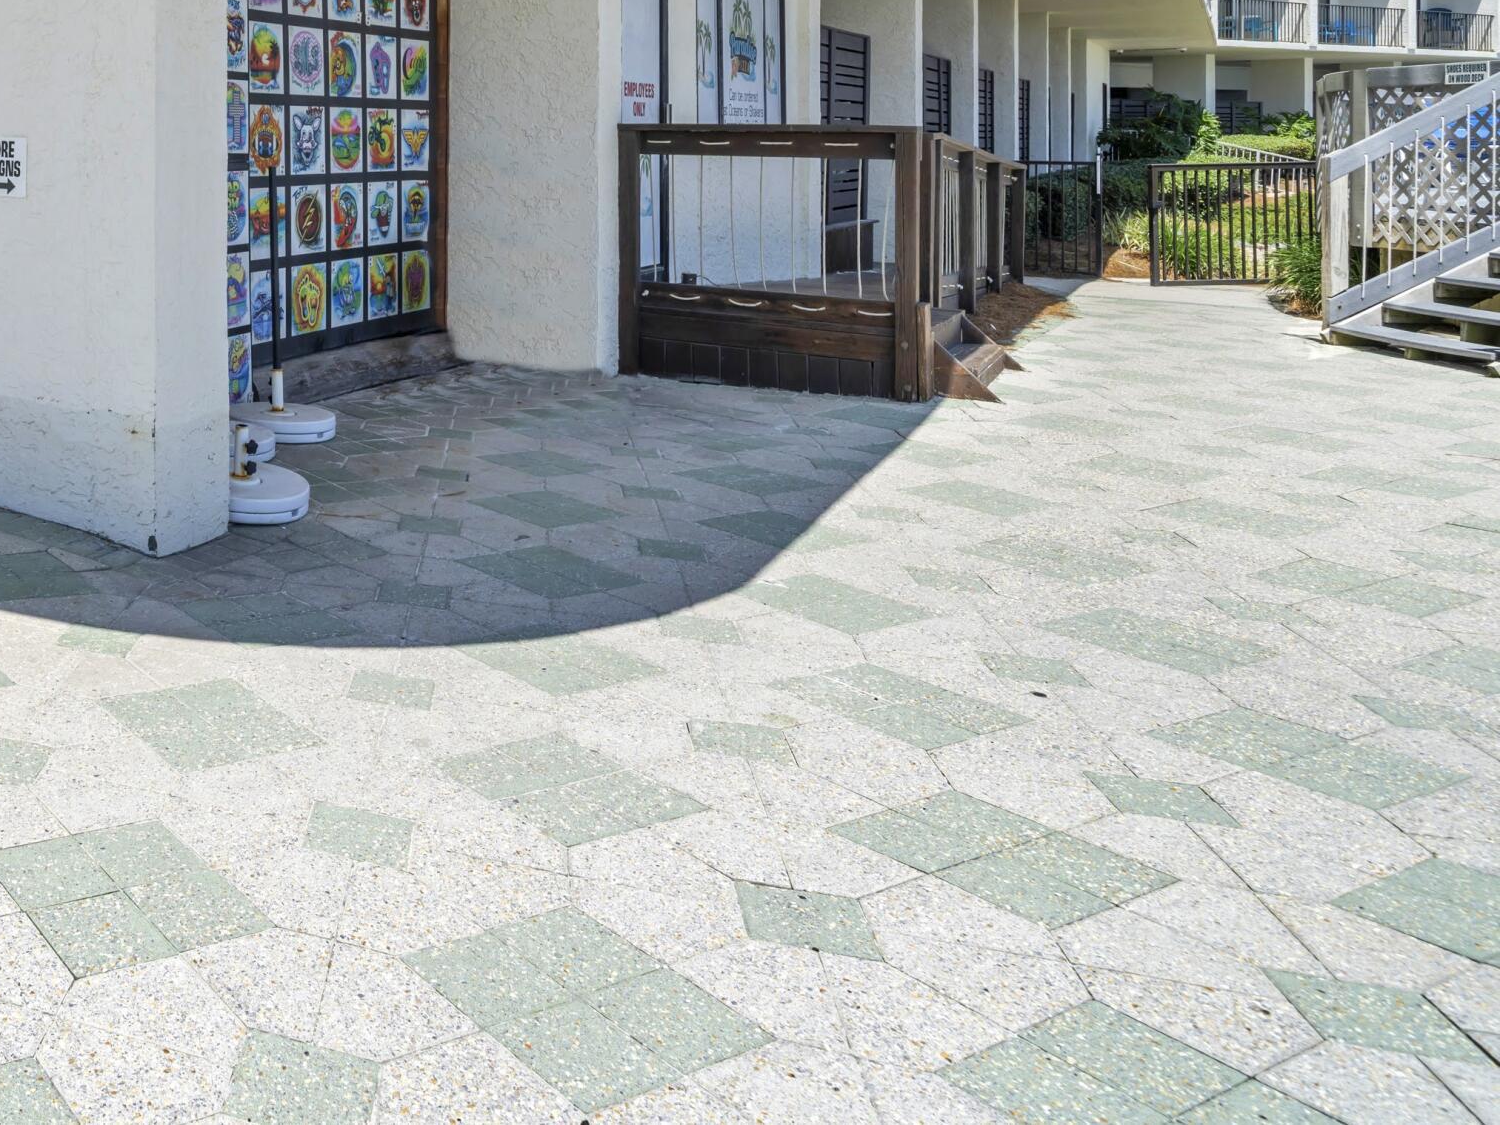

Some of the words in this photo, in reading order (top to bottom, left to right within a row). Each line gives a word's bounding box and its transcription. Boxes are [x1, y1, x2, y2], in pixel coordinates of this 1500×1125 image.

[1447, 64, 1461, 73] SHOES
[1463, 63, 1487, 73] REQUIRED
[1456, 74, 1470, 83] WOOD
[1472, 74, 1484, 82] DECK
[624, 81, 655, 98] EMPLOYEES
[729, 88, 737, 101] Can
[744, 91, 759, 103] ordered
[632, 102, 646, 116] ONLY
